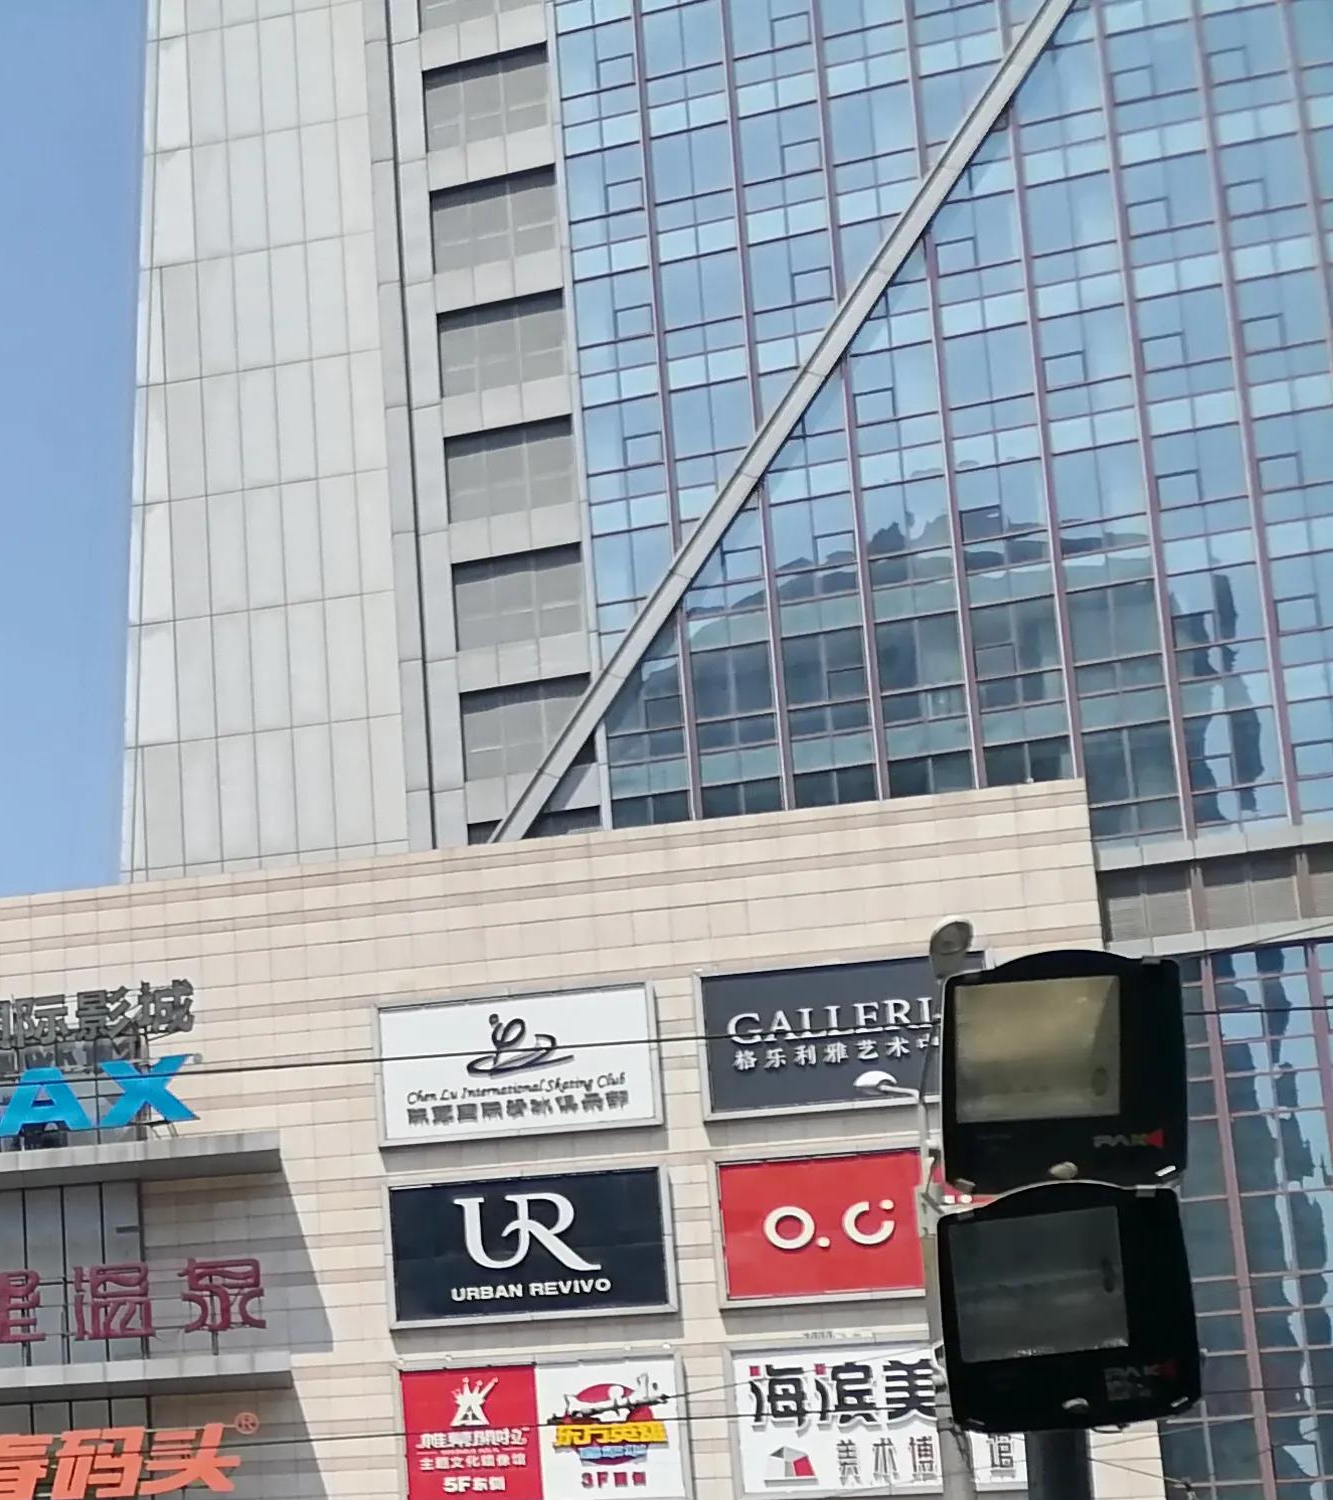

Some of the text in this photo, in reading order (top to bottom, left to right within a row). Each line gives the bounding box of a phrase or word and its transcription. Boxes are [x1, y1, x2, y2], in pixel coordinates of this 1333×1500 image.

[453, 1192, 602, 1271] UR
[451, 1278, 612, 1302] URBAN REVIVO
